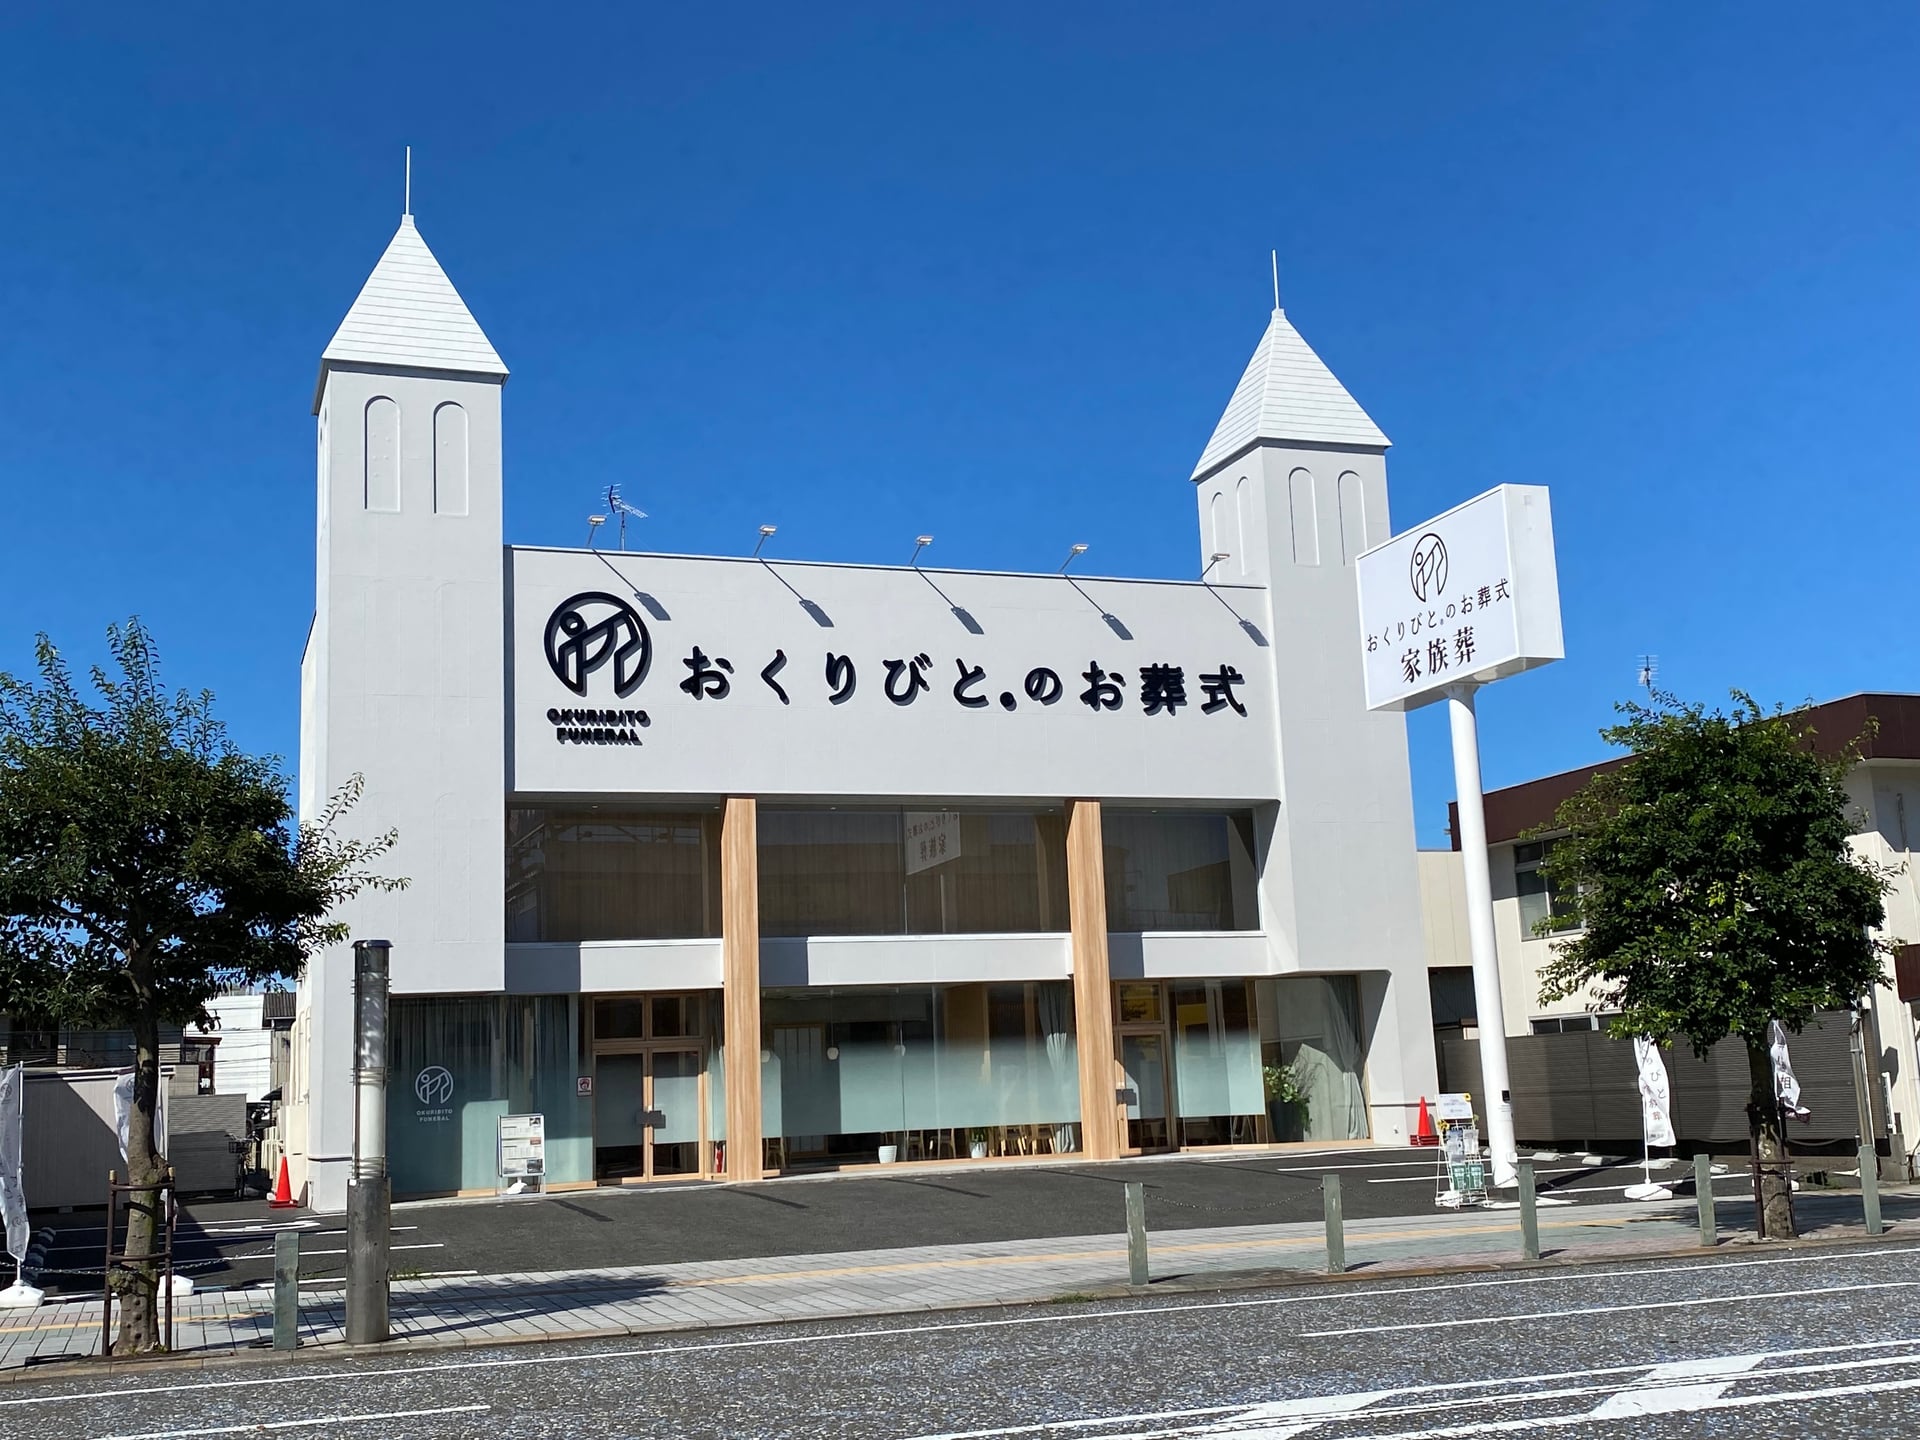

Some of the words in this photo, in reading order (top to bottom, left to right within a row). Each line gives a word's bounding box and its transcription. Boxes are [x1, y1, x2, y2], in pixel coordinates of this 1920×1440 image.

[1401, 626, 1476, 683] 家族葬
[546, 708, 650, 726] OKURIBITO
[556, 728, 641, 744] FUNERAL
[416, 1108, 453, 1116] OKURIBITO
